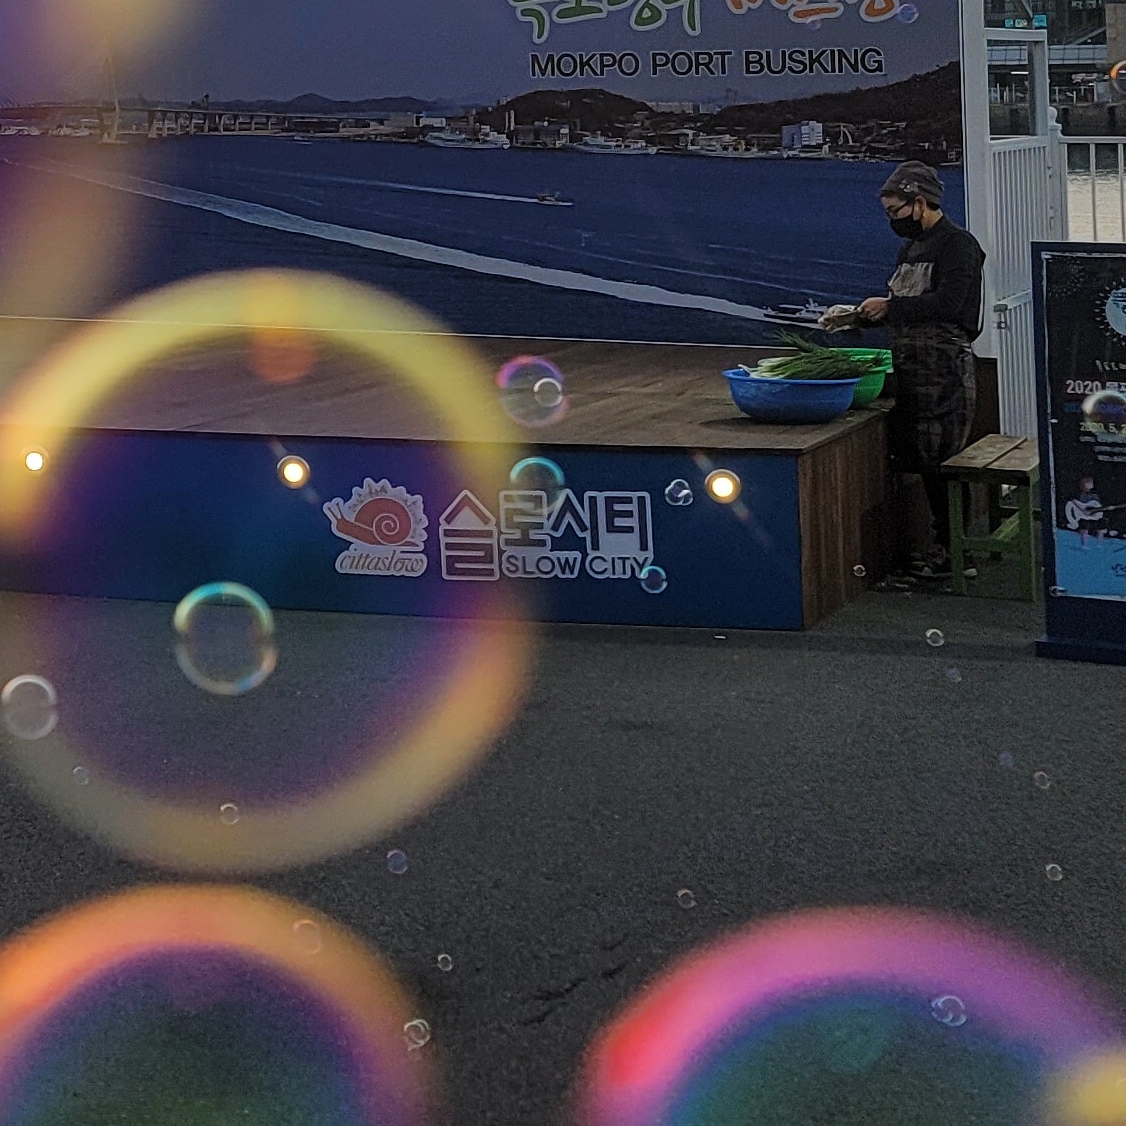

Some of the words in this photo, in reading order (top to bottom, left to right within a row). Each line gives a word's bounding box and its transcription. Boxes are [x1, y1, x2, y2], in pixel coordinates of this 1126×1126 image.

[530, 52, 640, 77] MOKPO
[651, 50, 732, 76] PORT
[743, 47, 884, 75] BUSKING
[1065, 379, 1103, 395] 2020
[440, 488, 654, 580] 슬로시티
[339, 549, 424, 574] cittaslow
[504, 553, 580, 577] SLOW
[585, 553, 654, 576] CITY
